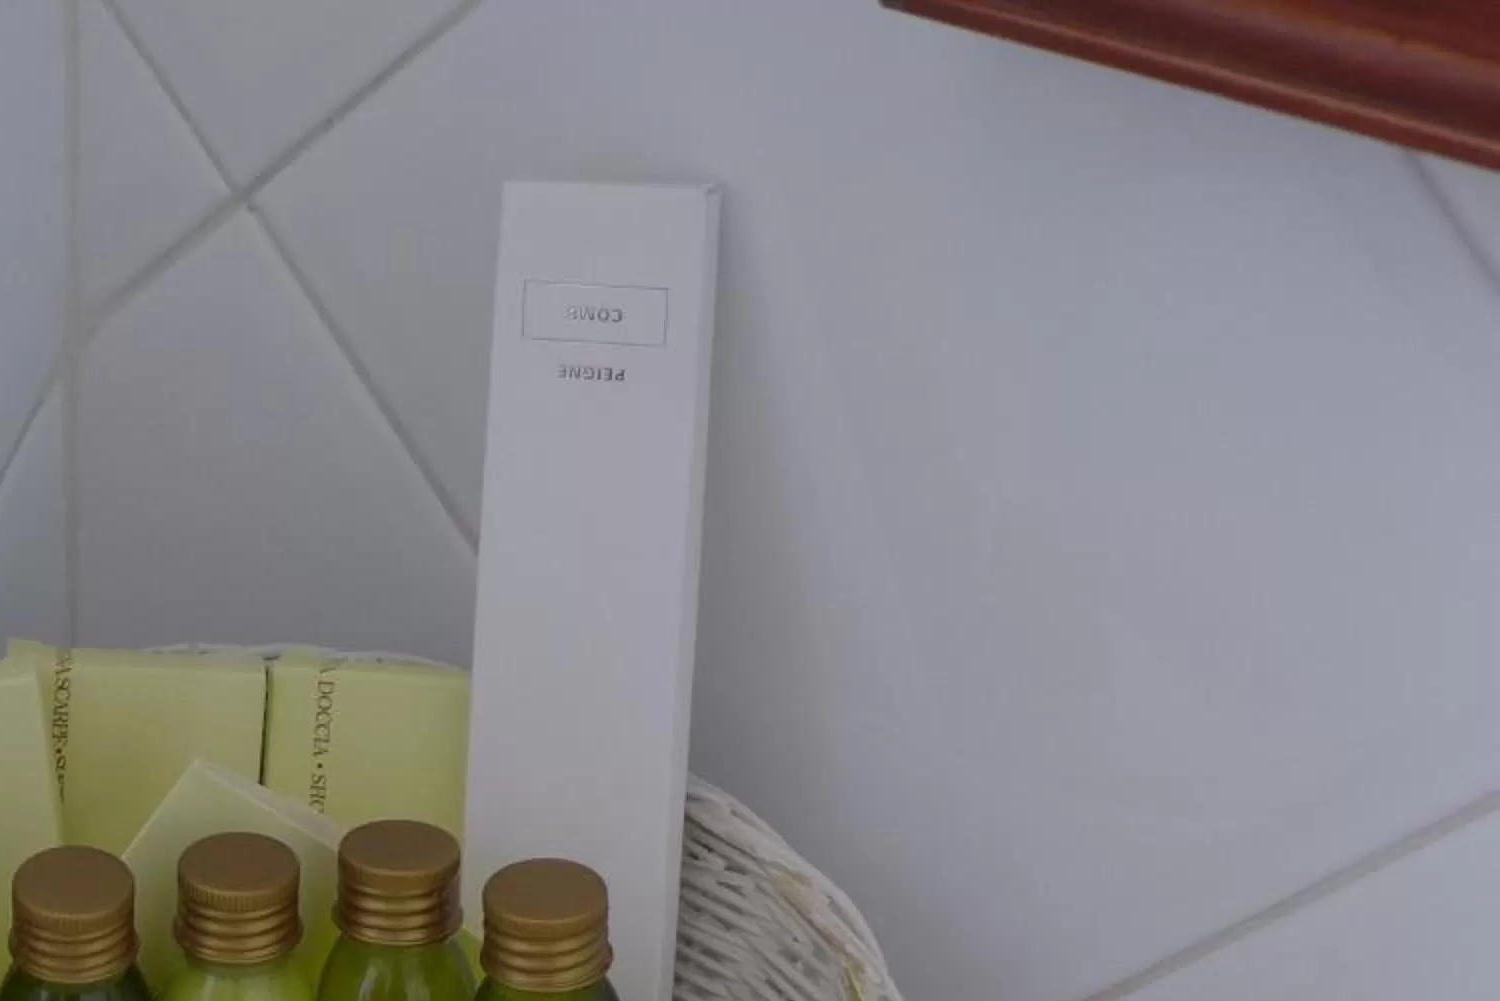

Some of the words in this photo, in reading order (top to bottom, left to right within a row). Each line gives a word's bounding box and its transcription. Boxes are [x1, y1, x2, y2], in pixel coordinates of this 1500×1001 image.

[566, 305, 624, 324] COMB
[558, 364, 626, 381] PEIGNE
[313, 681, 334, 754] DOCCIA
